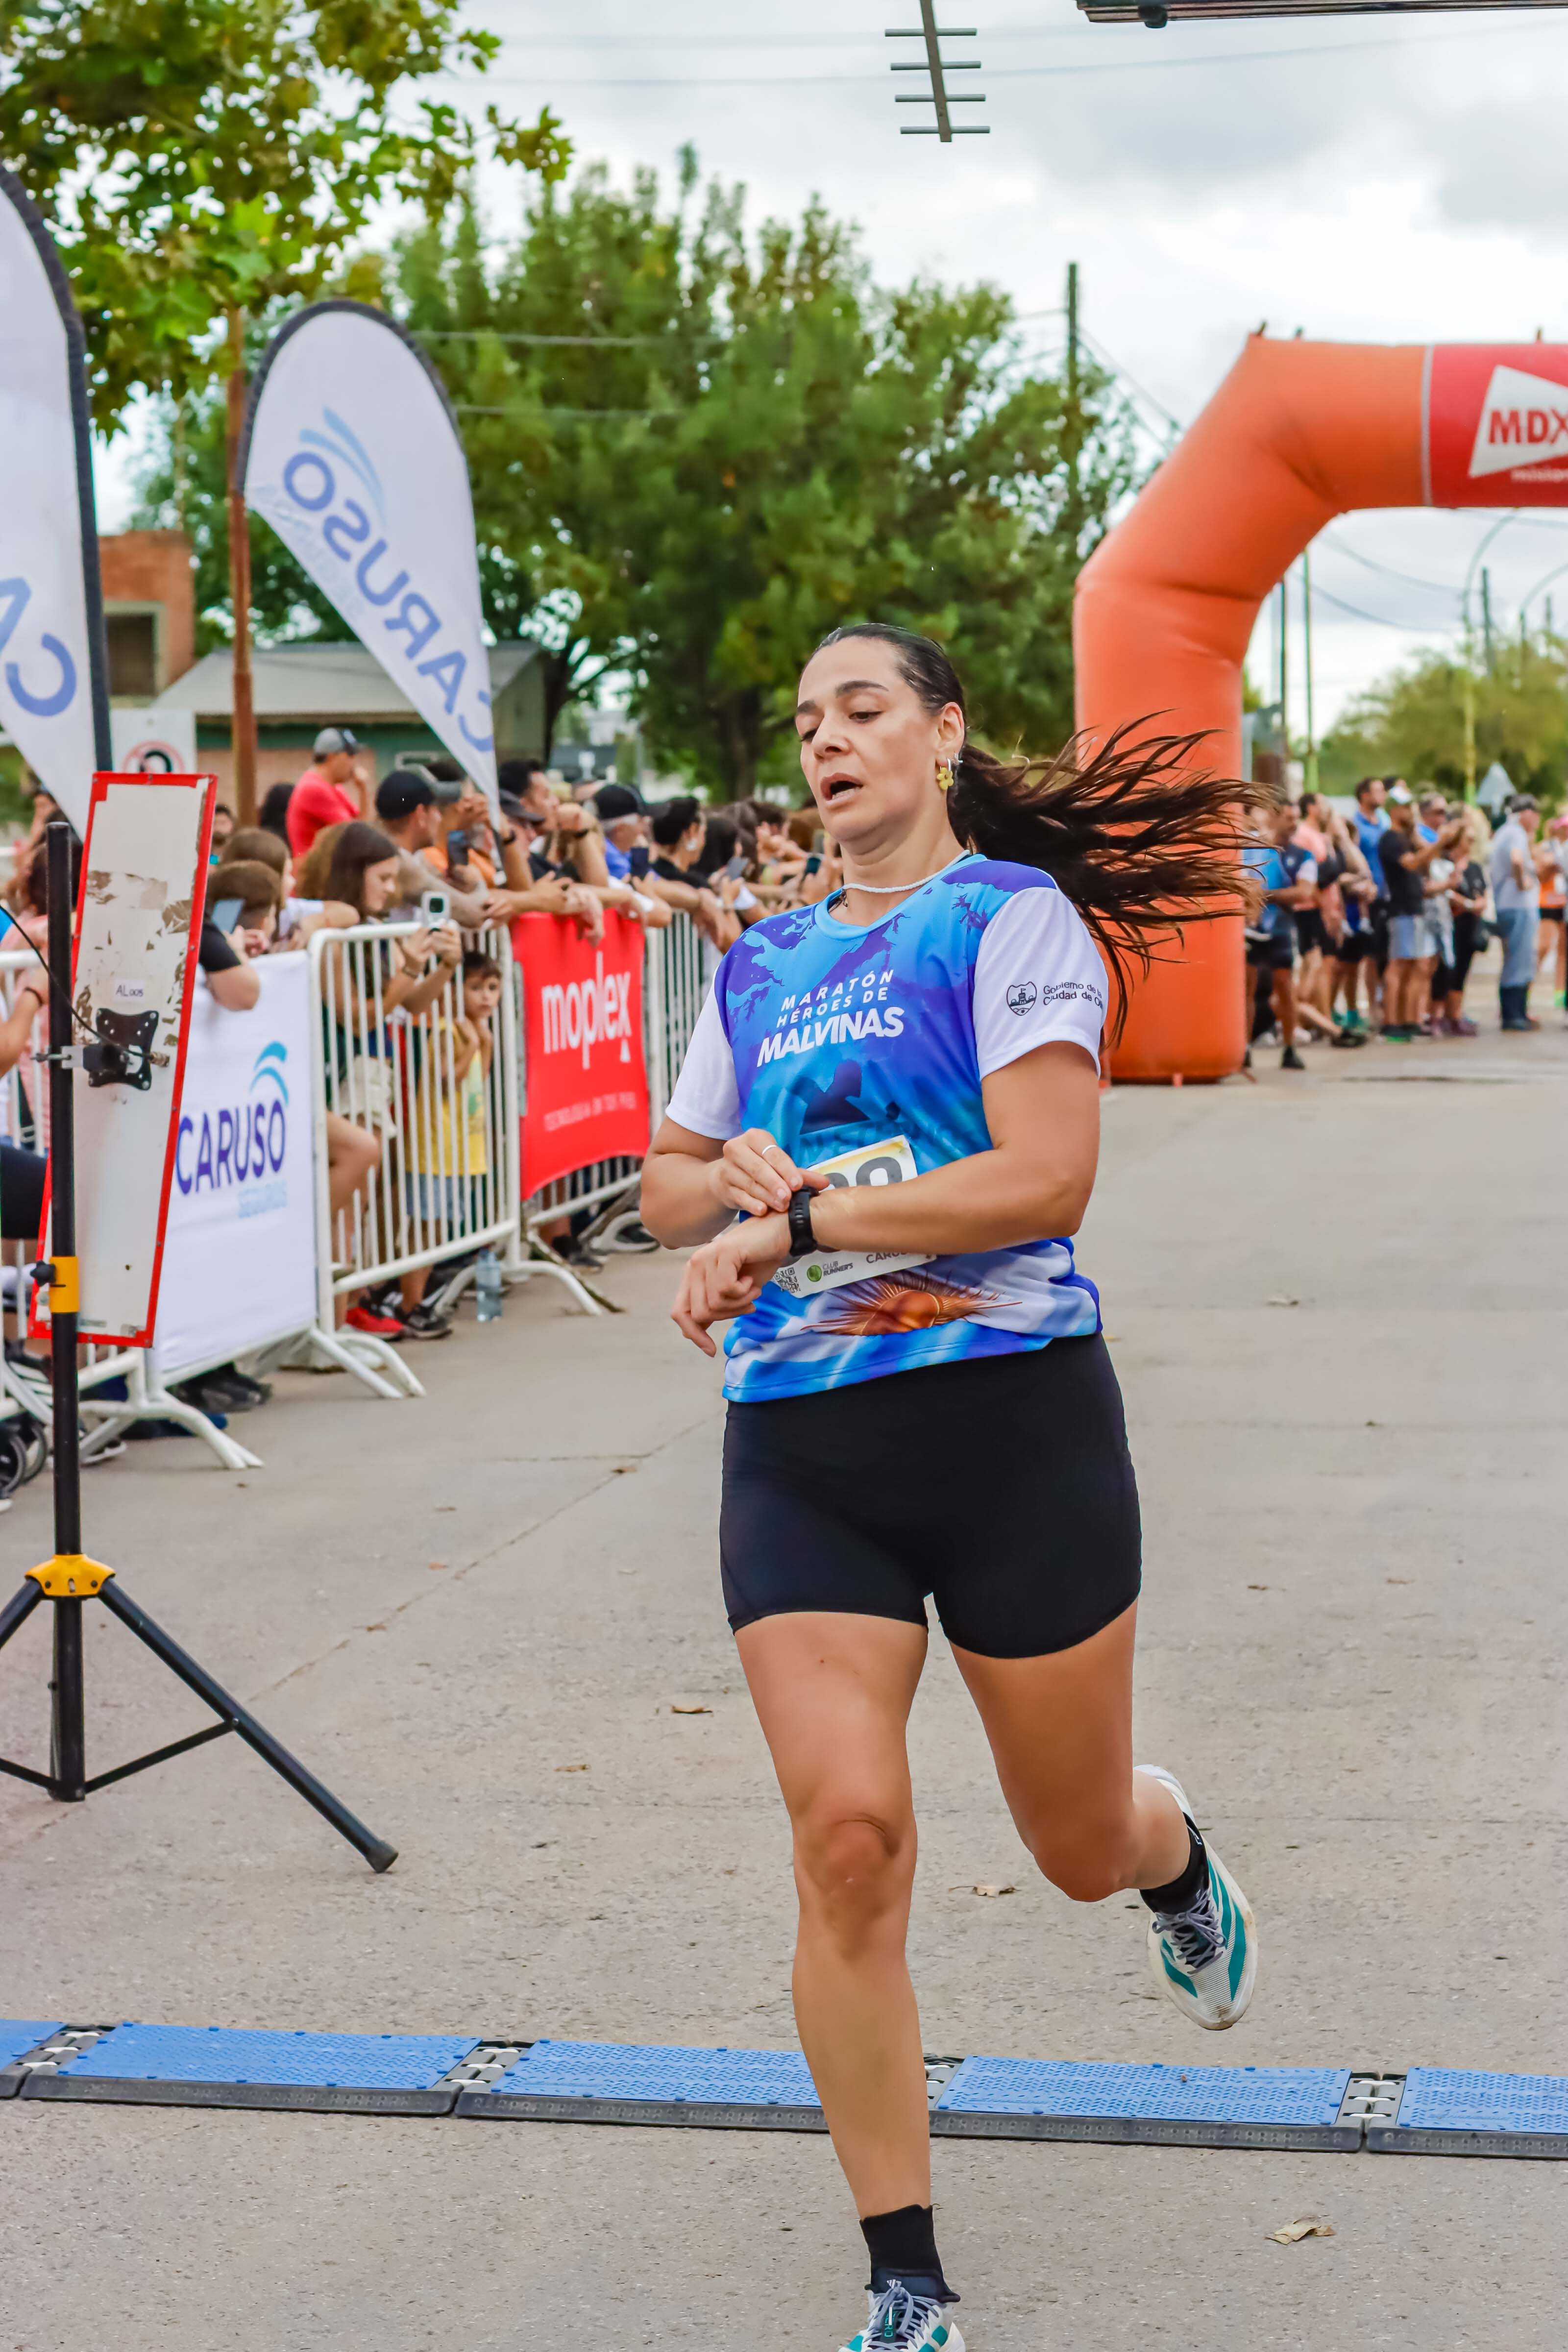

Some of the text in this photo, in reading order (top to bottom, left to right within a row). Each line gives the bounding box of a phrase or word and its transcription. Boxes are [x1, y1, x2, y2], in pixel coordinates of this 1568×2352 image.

[776, 987, 888, 1028] HÉROES DE
[781, 970, 894, 1012] MARATÓN
[1043, 990, 1077, 1005] Ciudad
[1081, 991, 1092, 1002] de
[1087, 984, 1096, 994] de
[541, 951, 631, 1069] moplex
[757, 1006, 905, 1068] MALVINAS
[175, 1100, 286, 1196] CARUSO
[823, 1261, 838, 1270] CLUB
